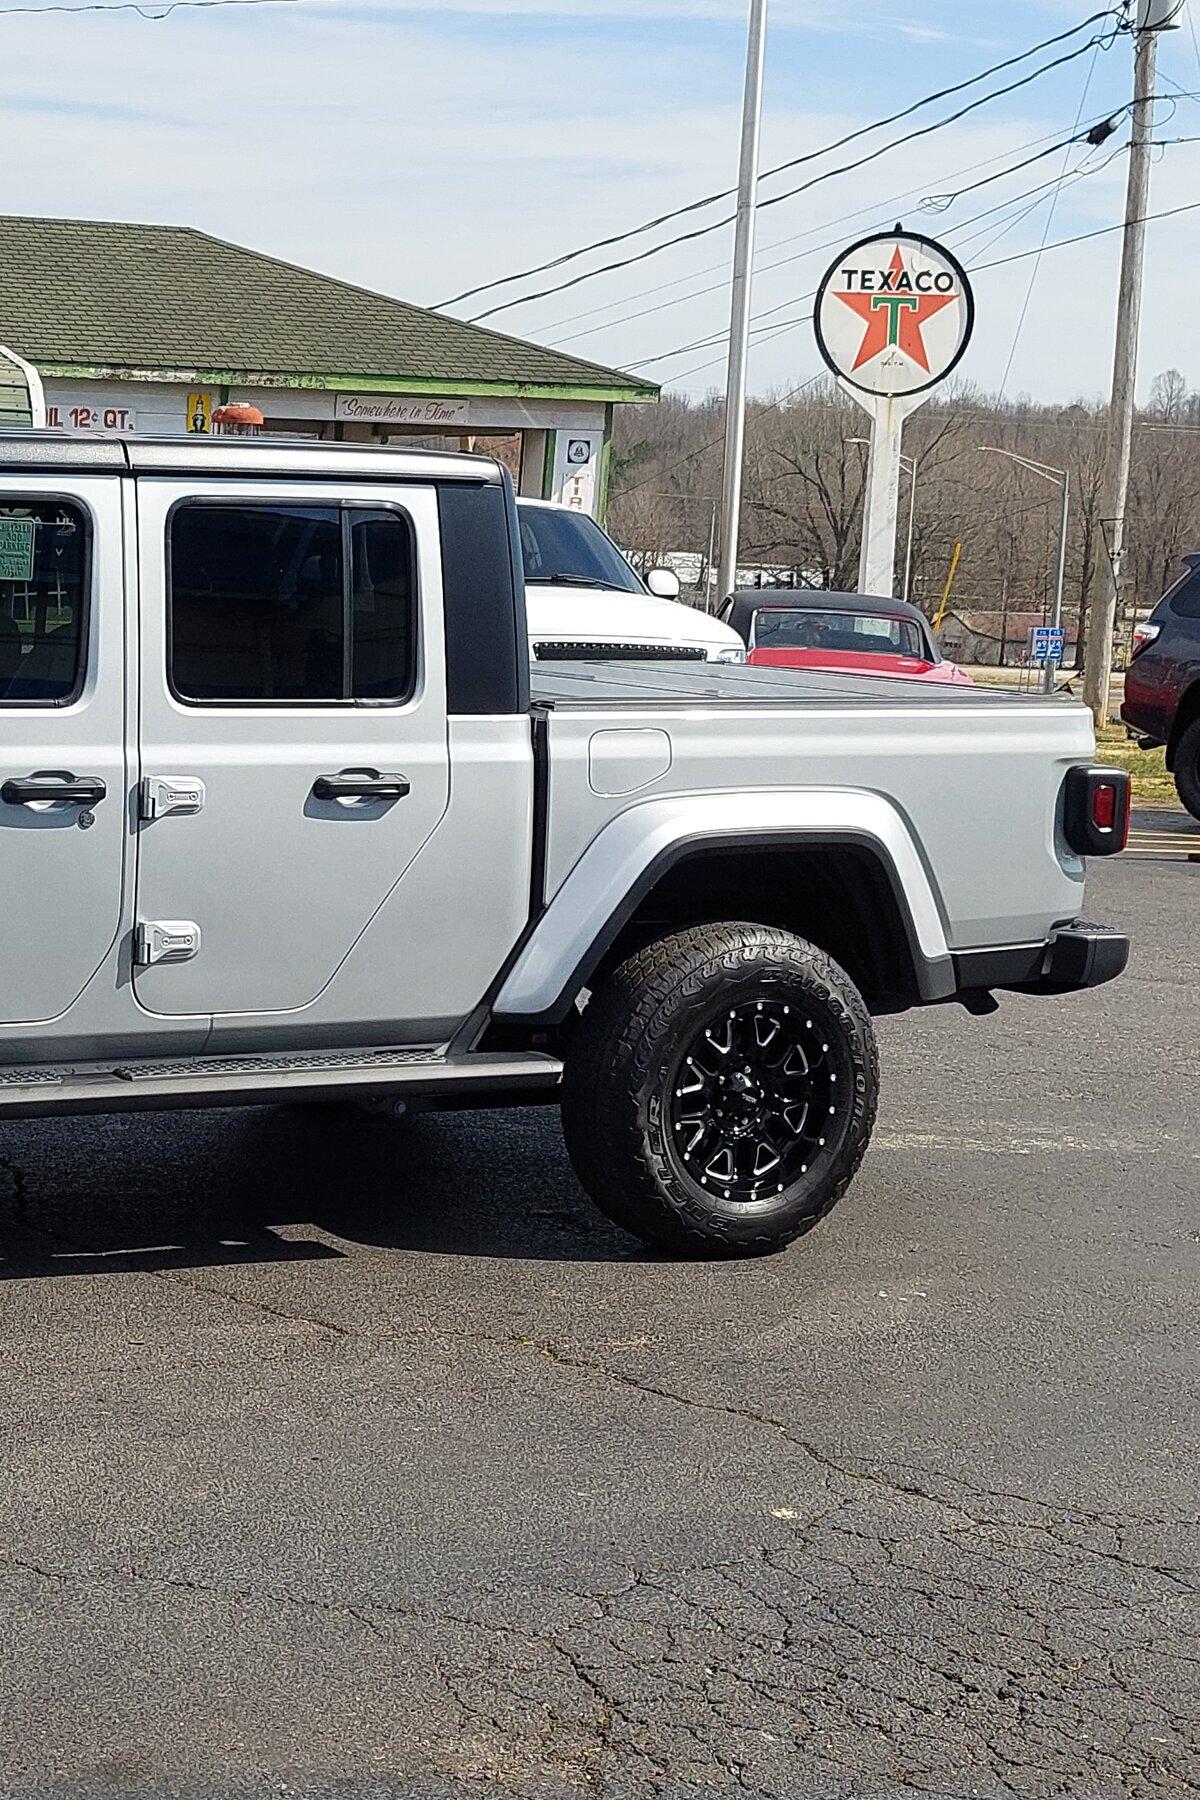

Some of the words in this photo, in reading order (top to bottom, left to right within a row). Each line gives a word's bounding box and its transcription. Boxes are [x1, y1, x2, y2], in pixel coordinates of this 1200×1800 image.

[841, 270, 954, 293] TEXACO
[46, 407, 63, 428] IL
[409, 405, 422, 418] in
